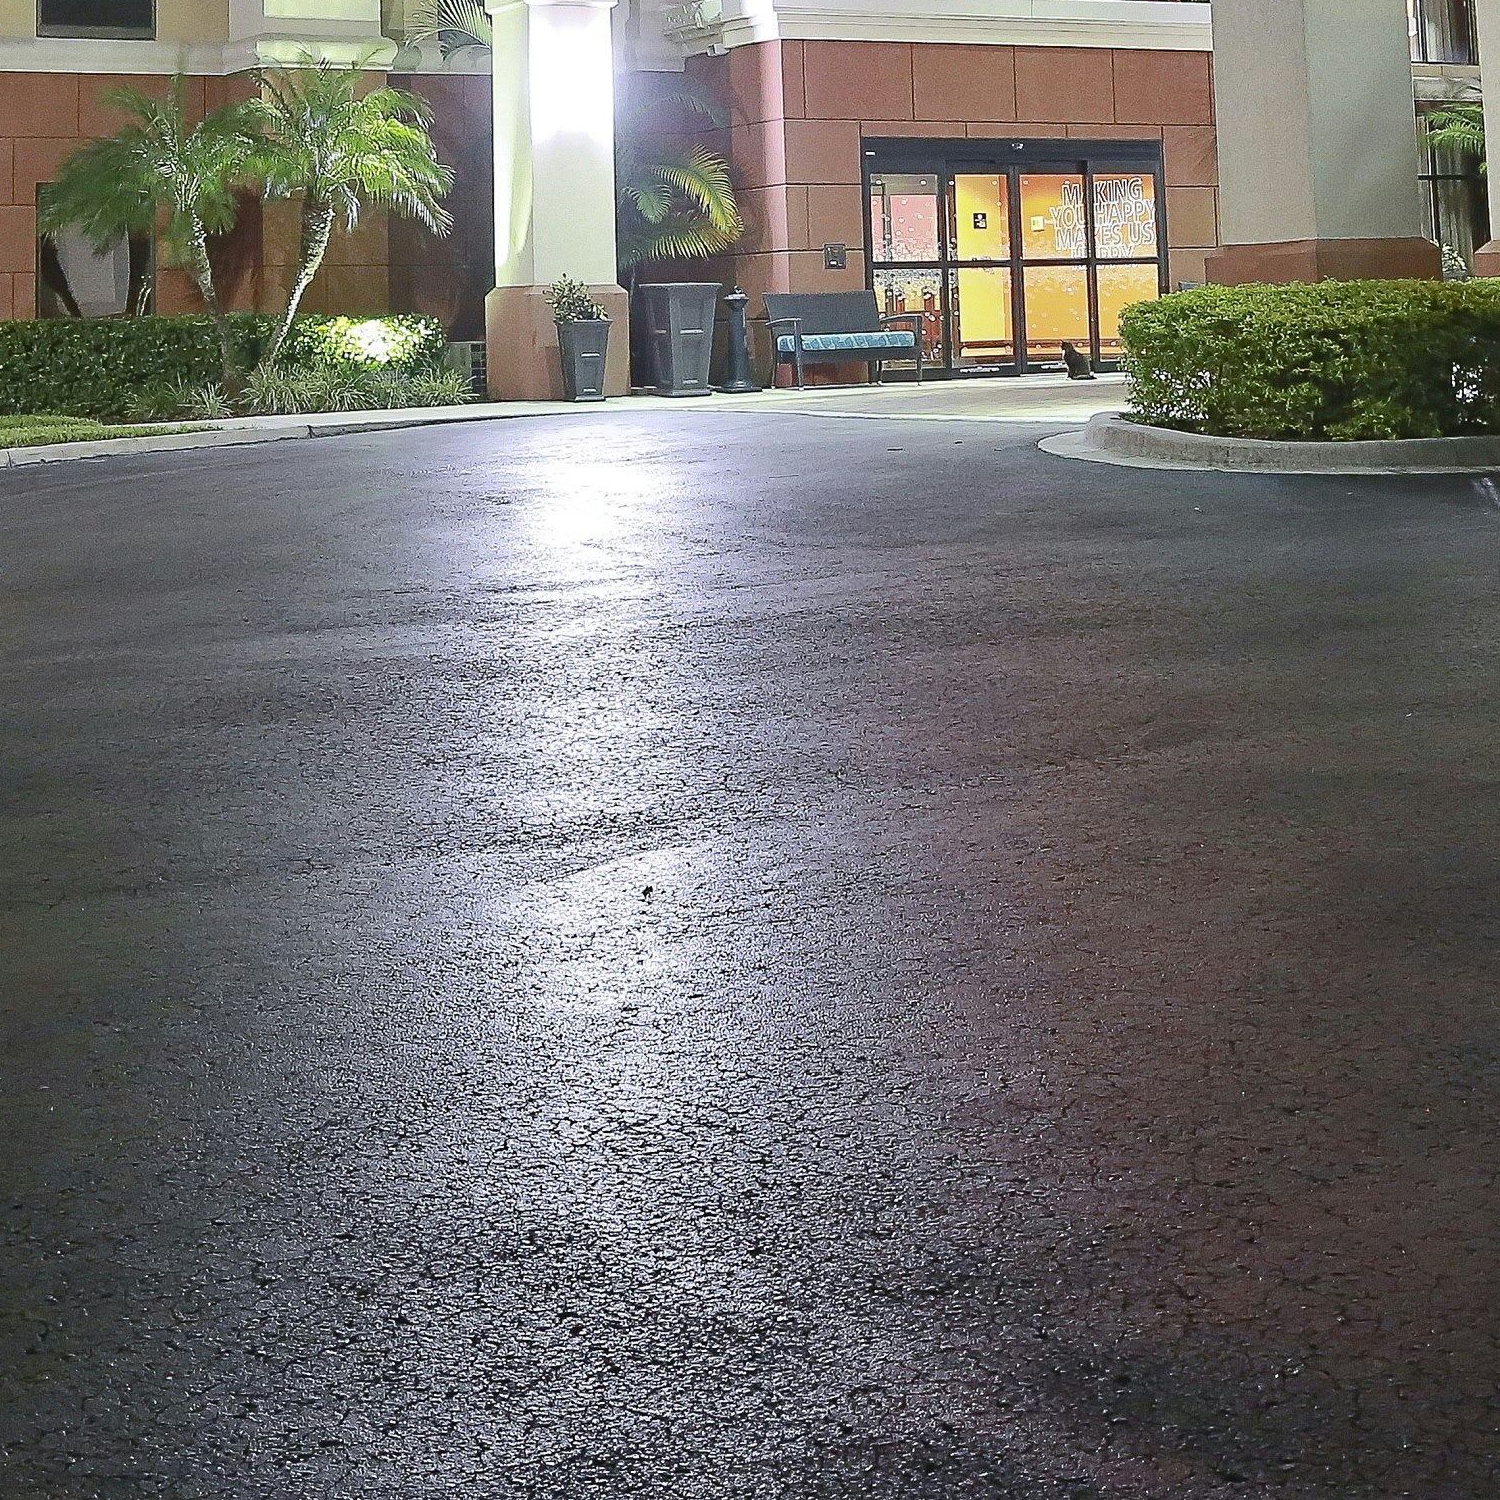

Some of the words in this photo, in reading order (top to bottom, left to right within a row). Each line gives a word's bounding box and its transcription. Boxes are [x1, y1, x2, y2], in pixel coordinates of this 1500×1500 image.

[1062, 178, 1143, 207] MKING
[1094, 198, 1156, 227] HAPPY
[1128, 221, 1157, 244] US
